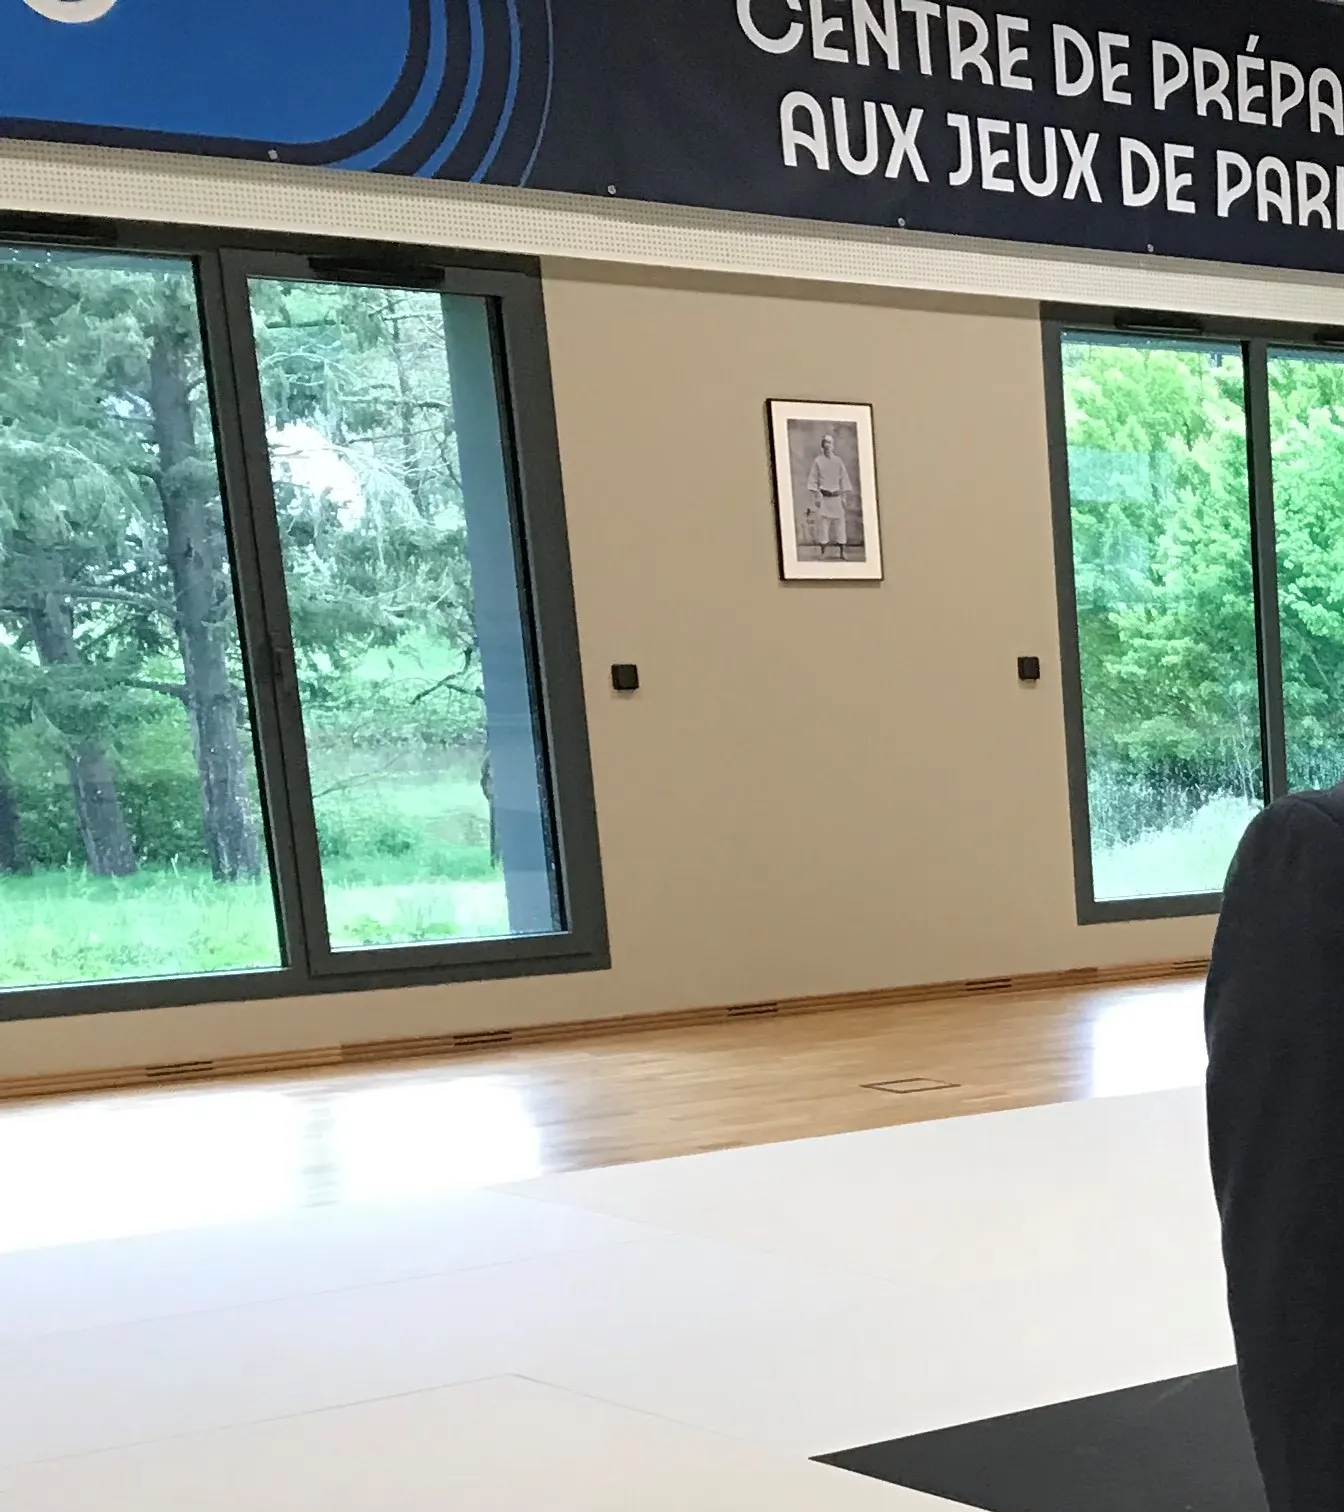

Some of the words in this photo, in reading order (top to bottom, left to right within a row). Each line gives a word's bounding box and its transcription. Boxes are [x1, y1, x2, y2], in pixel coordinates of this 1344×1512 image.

[737, 0, 1030, 90] CENTRE
[1053, 23, 1131, 106] DE
[780, 91, 928, 184] AUX
[947, 114, 1102, 204] JEUX
[1121, 138, 1195, 214] DE
